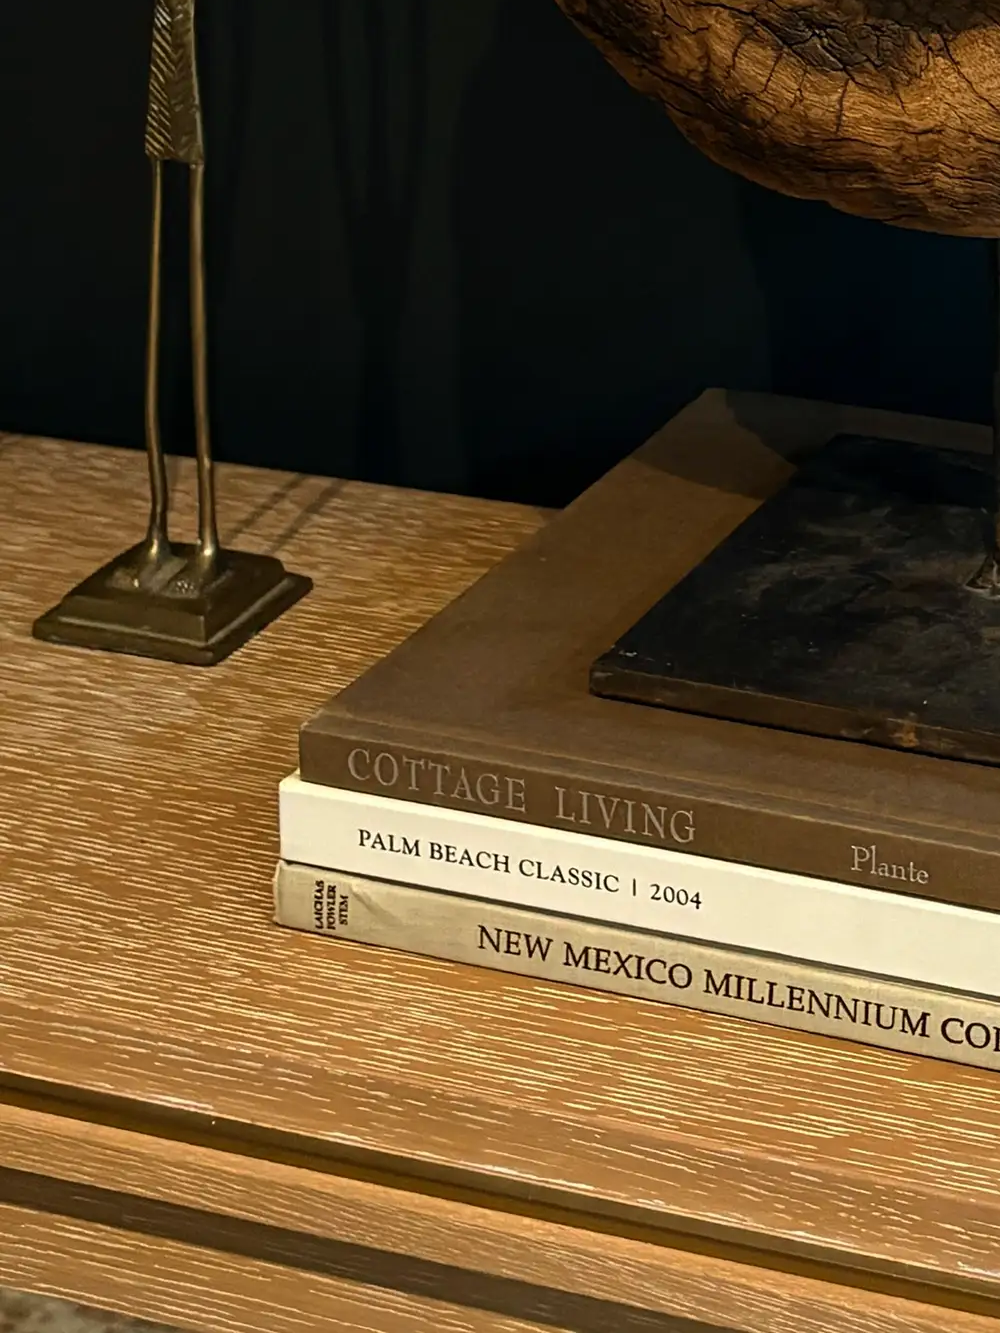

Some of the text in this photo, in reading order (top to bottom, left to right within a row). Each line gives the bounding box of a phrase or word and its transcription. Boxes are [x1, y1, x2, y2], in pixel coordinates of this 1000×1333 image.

[347, 747, 696, 844] COTTAGE LIVING
[358, 827, 422, 858] PALM
[429, 842, 511, 874] BEACH
[518, 859, 620, 893] CLASSIC
[650, 883, 703, 911] 2004
[850, 844, 930, 886] Plante
[477, 925, 554, 962] NEW
[562, 941, 693, 990] MEXICO
[703, 968, 931, 1040] MILLENNIUM
